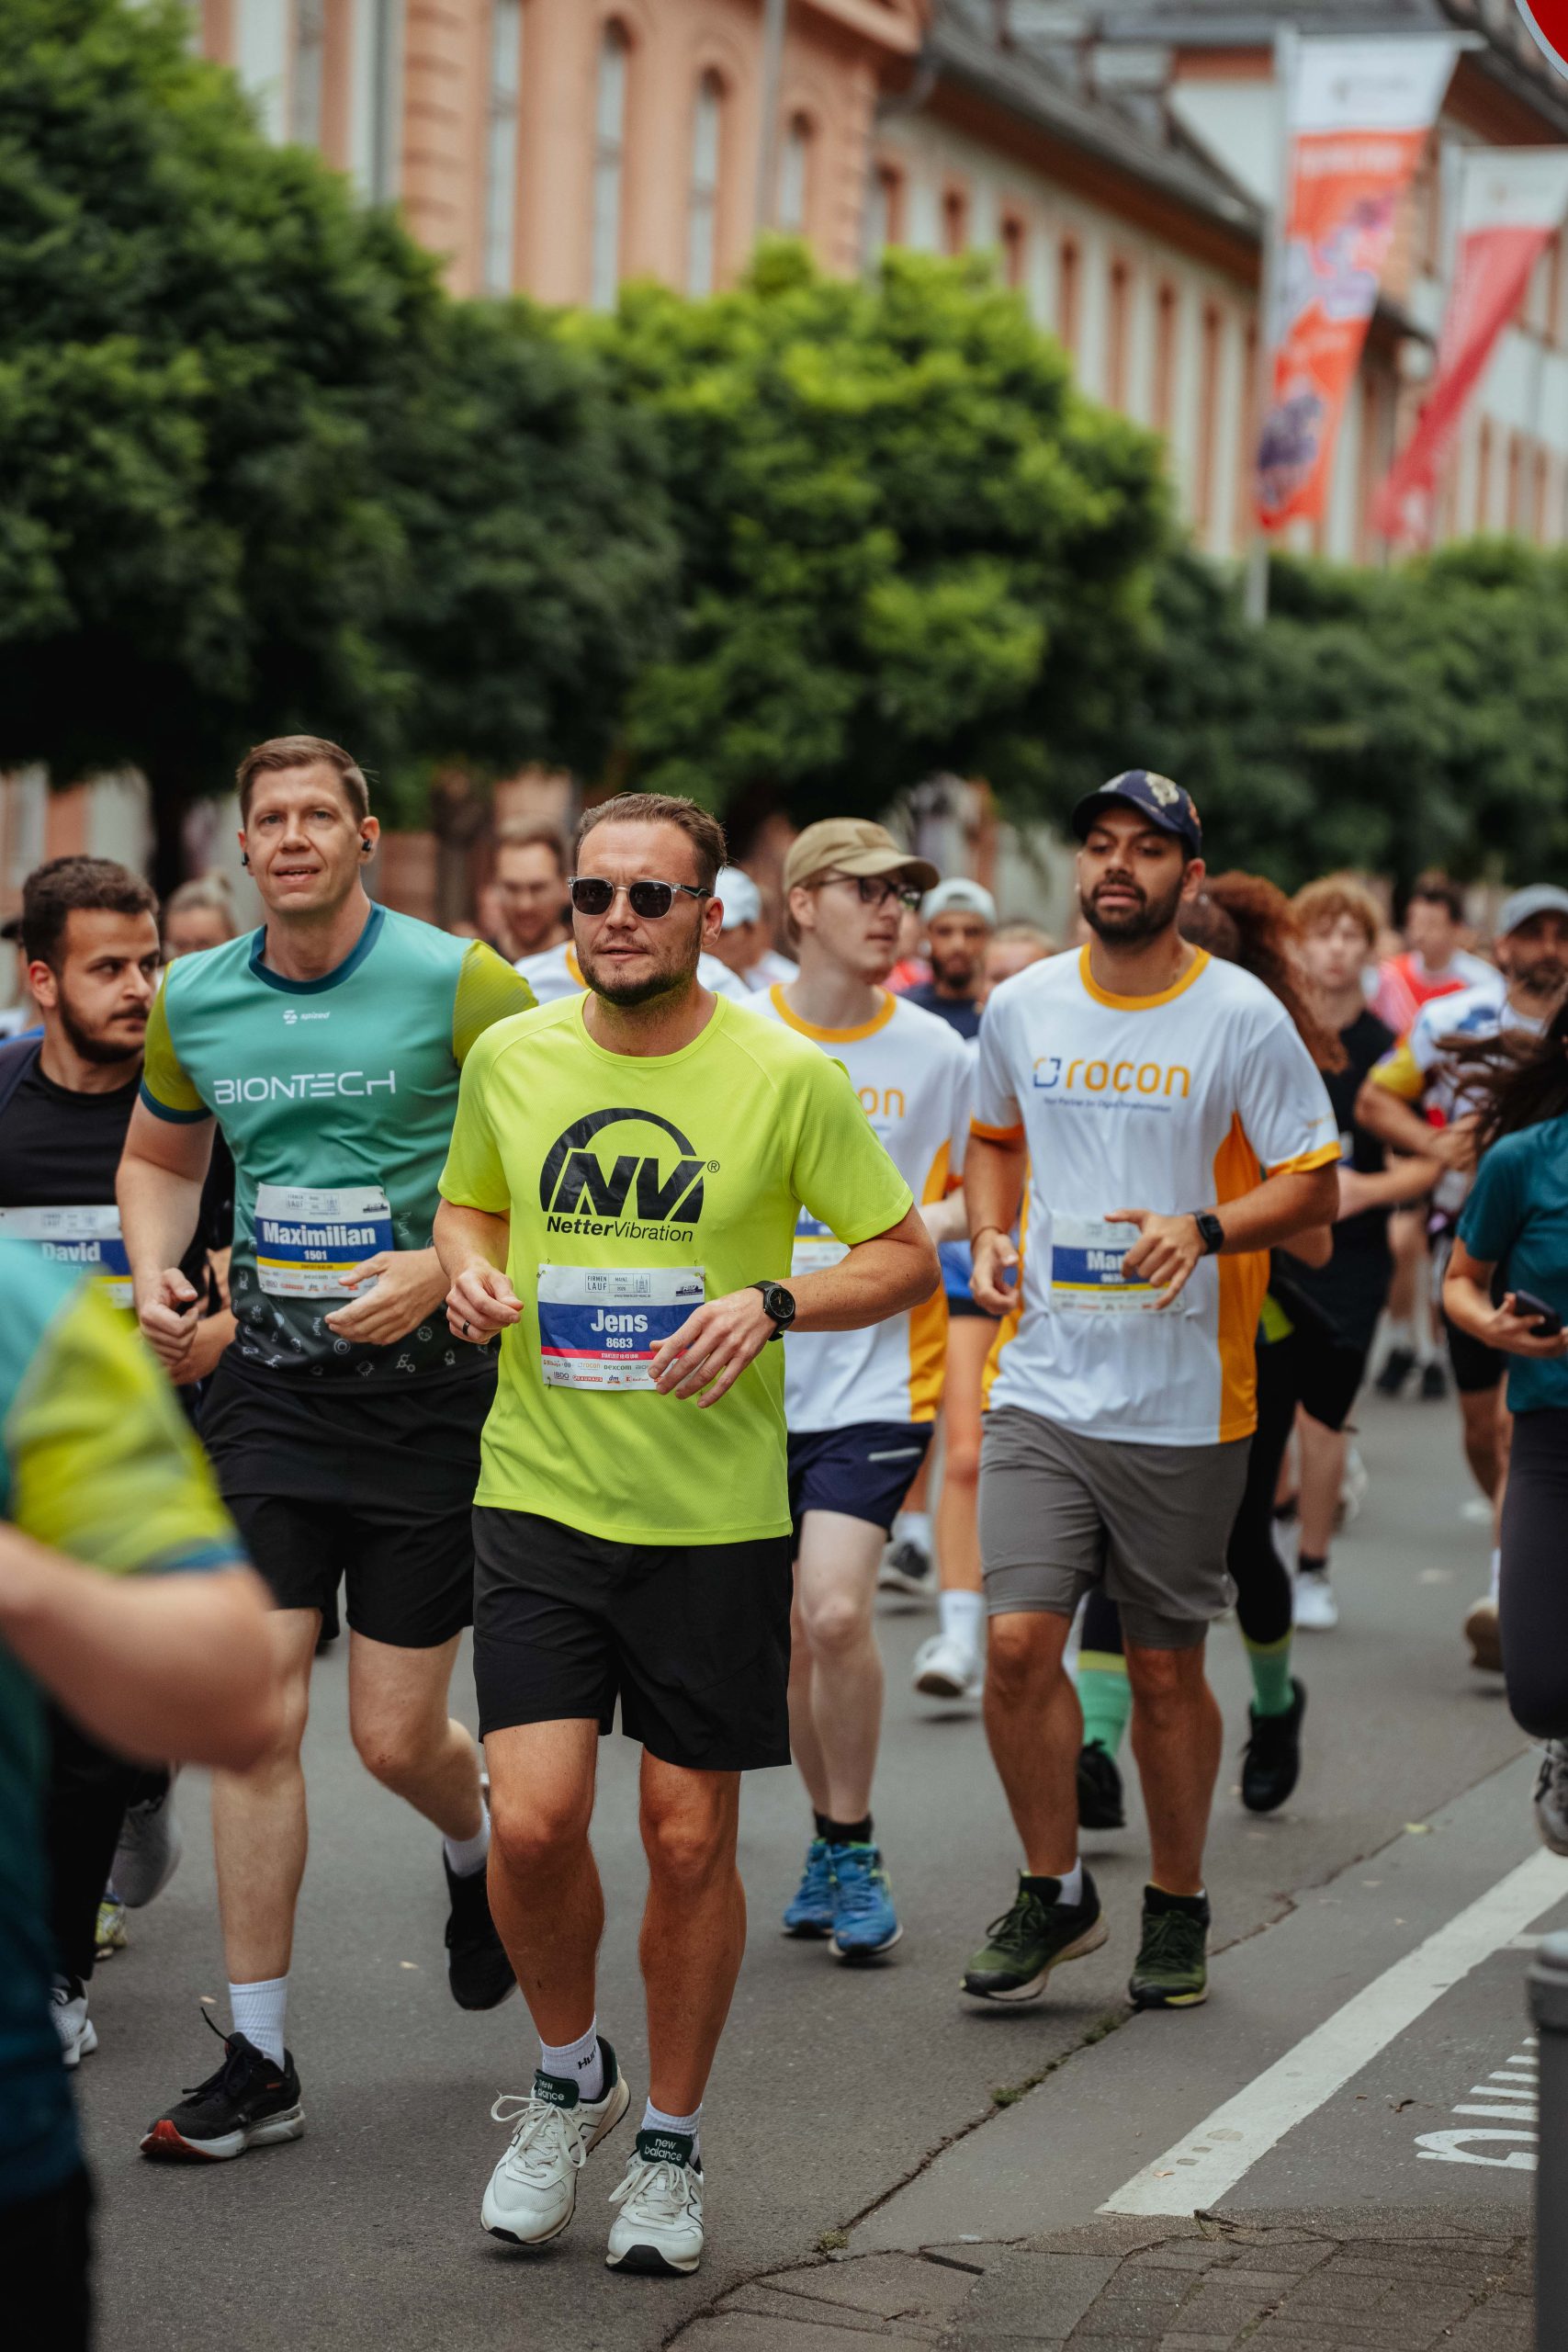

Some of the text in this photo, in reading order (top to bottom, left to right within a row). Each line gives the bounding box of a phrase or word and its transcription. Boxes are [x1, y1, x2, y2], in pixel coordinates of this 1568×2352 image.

[213, 1069, 396, 1104] BIONTECH
[1066, 1059, 1190, 1100] rocon
[263, 1221, 377, 1246] Maximilian
[547, 1216, 694, 1242] NetterVibration
[41, 1241, 101, 1261] David
[303, 1250, 328, 1261] 1501
[587, 1283, 607, 1291] LAUF
[590, 1309, 649, 1333] Jens
[605, 1338, 633, 1349] 8683
[644, 2143, 682, 2162] balance
[655, 2138, 676, 2150] new
